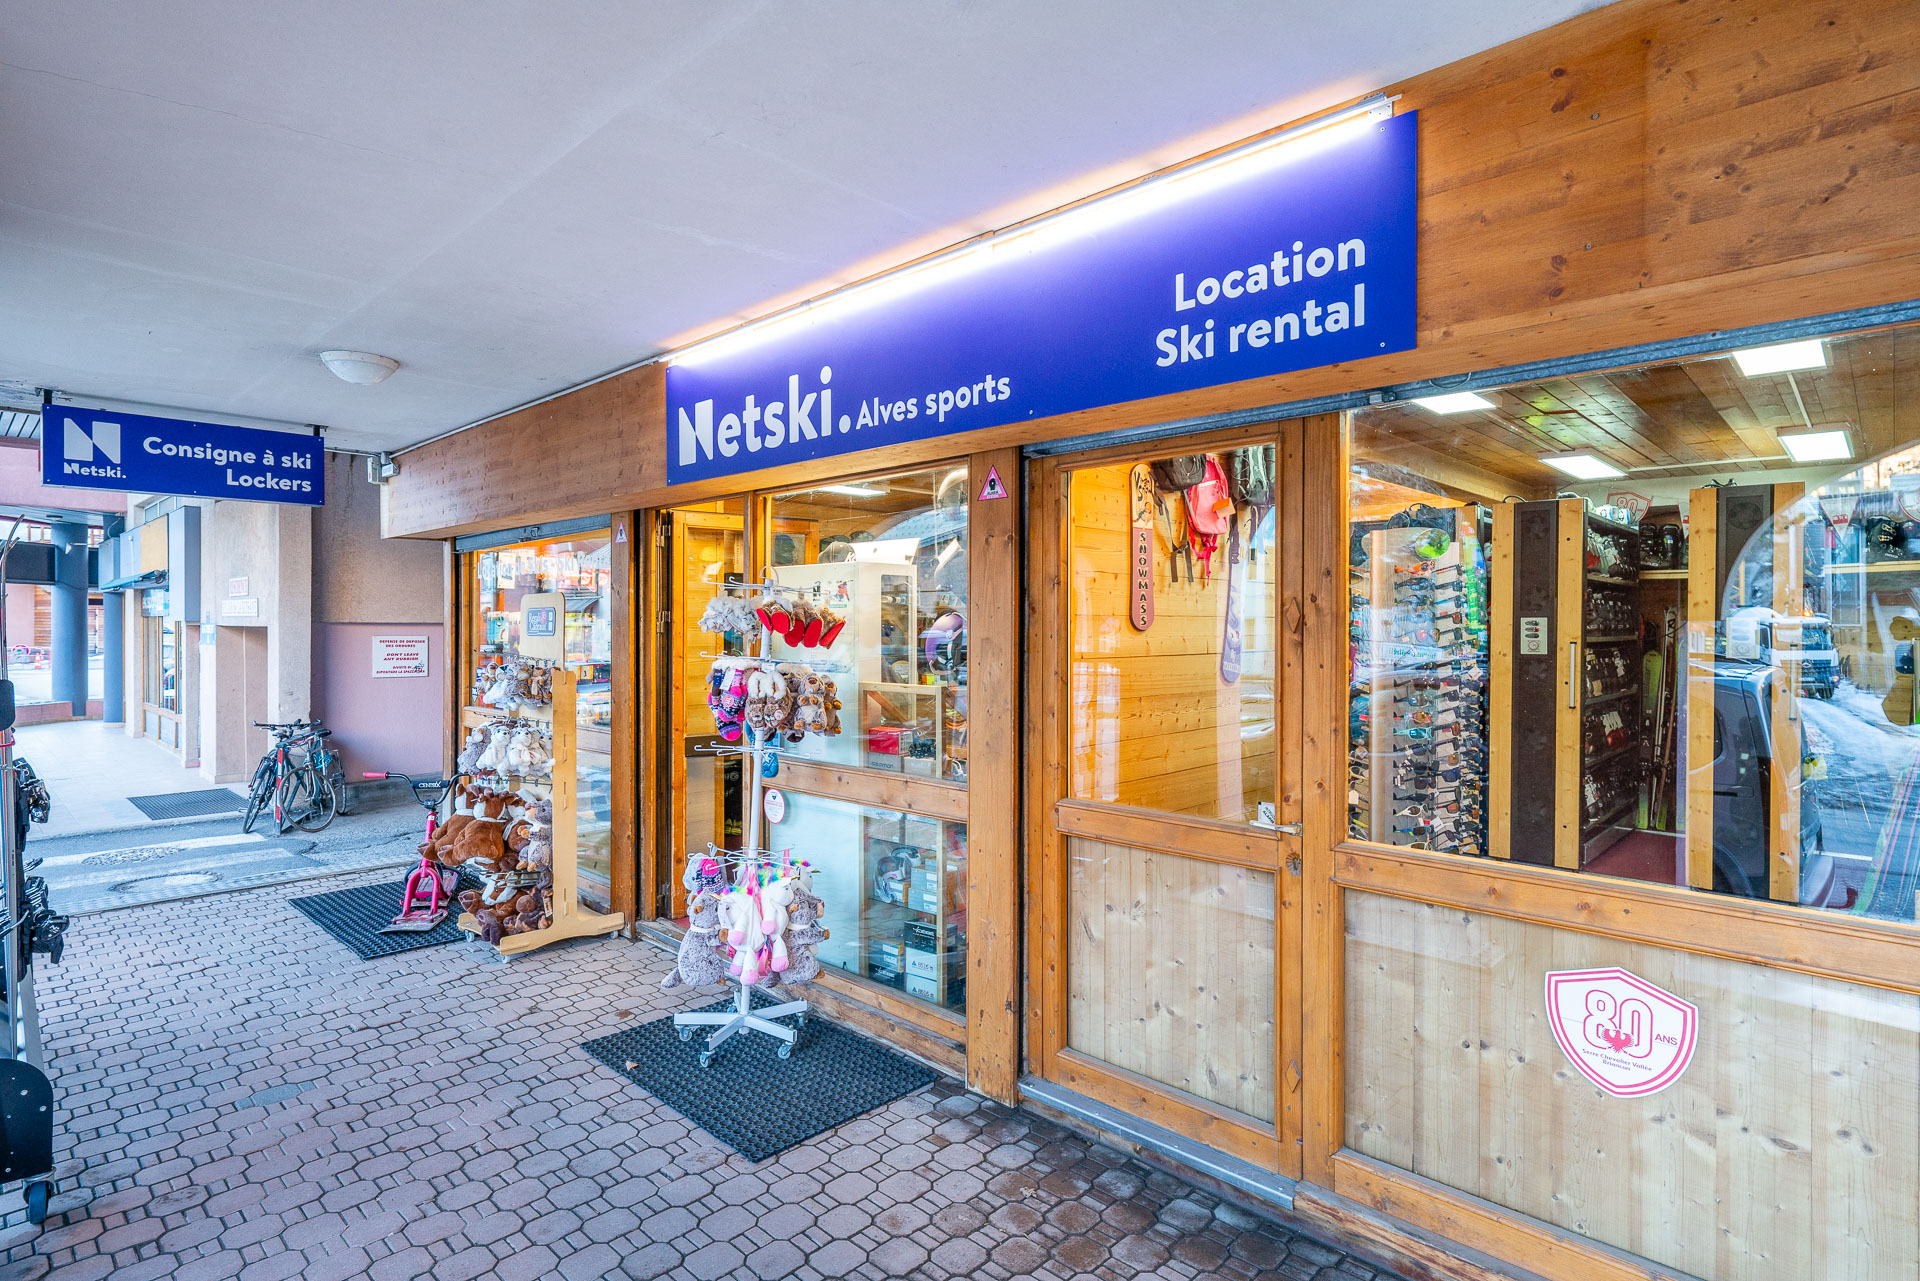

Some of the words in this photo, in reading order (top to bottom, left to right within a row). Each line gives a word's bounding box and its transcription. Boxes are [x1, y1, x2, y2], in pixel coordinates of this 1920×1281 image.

[1175, 238, 1366, 312] Location
[1155, 318, 1215, 367] Ski
[1229, 282, 1366, 353] rental
[678, 365, 851, 466] Netski.
[855, 396, 918, 430] Alves
[925, 374, 1011, 423] sports
[63, 461, 127, 479] Netski.
[142, 436, 257, 466] Consigne
[262, 449, 275, 466] à
[281, 451, 312, 470] ski
[226, 468, 312, 492] Lockers
[1138, 532, 1149, 627] SNOWMASS
[1583, 989, 1653, 1059] 80
[1654, 1033, 1678, 1046] ANS
